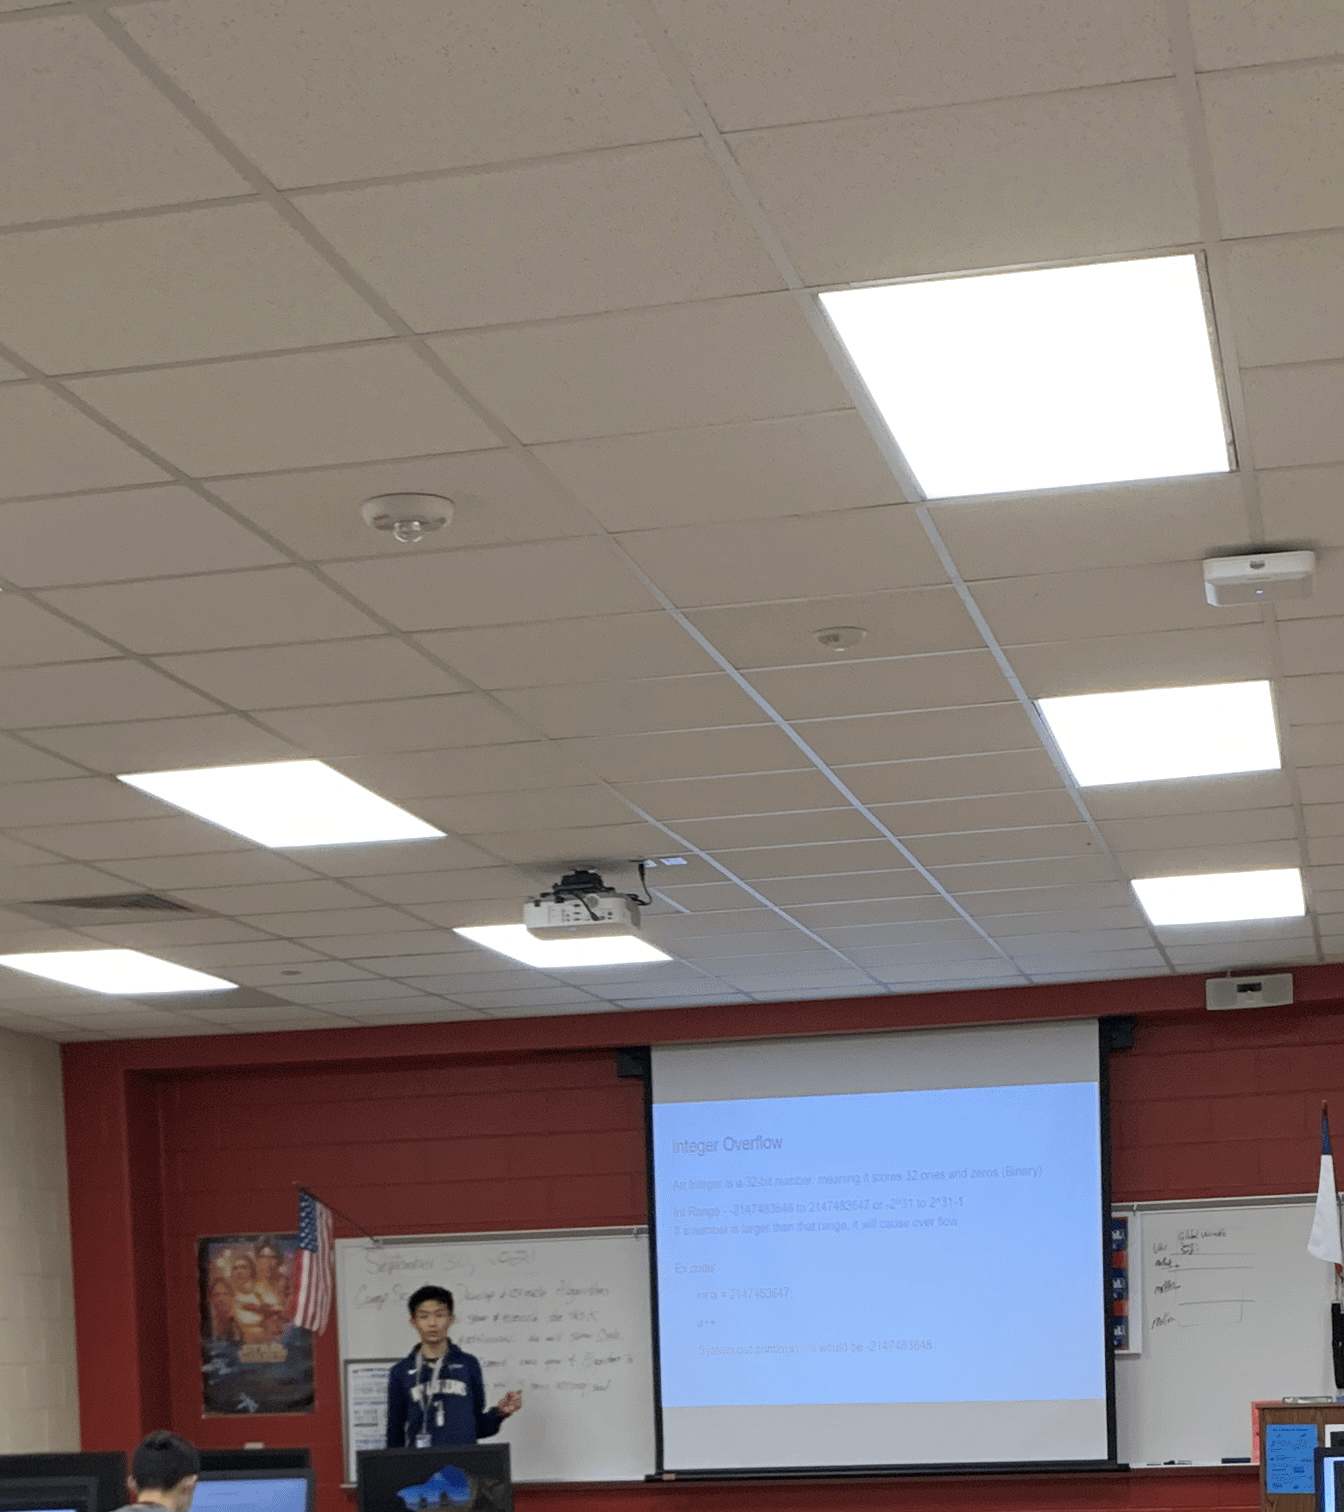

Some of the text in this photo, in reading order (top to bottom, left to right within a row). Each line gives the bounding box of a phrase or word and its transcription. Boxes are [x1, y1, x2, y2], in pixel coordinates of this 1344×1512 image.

[672, 1135, 784, 1156] Integer Overflow
[905, 1169, 918, 1181] 32
[920, 1170, 945, 1180] ones
[948, 1167, 968, 1179] and
[970, 1168, 999, 1179] zeros
[1002, 1165, 1043, 1179] (Binary)
[916, 1198, 927, 1208] to
